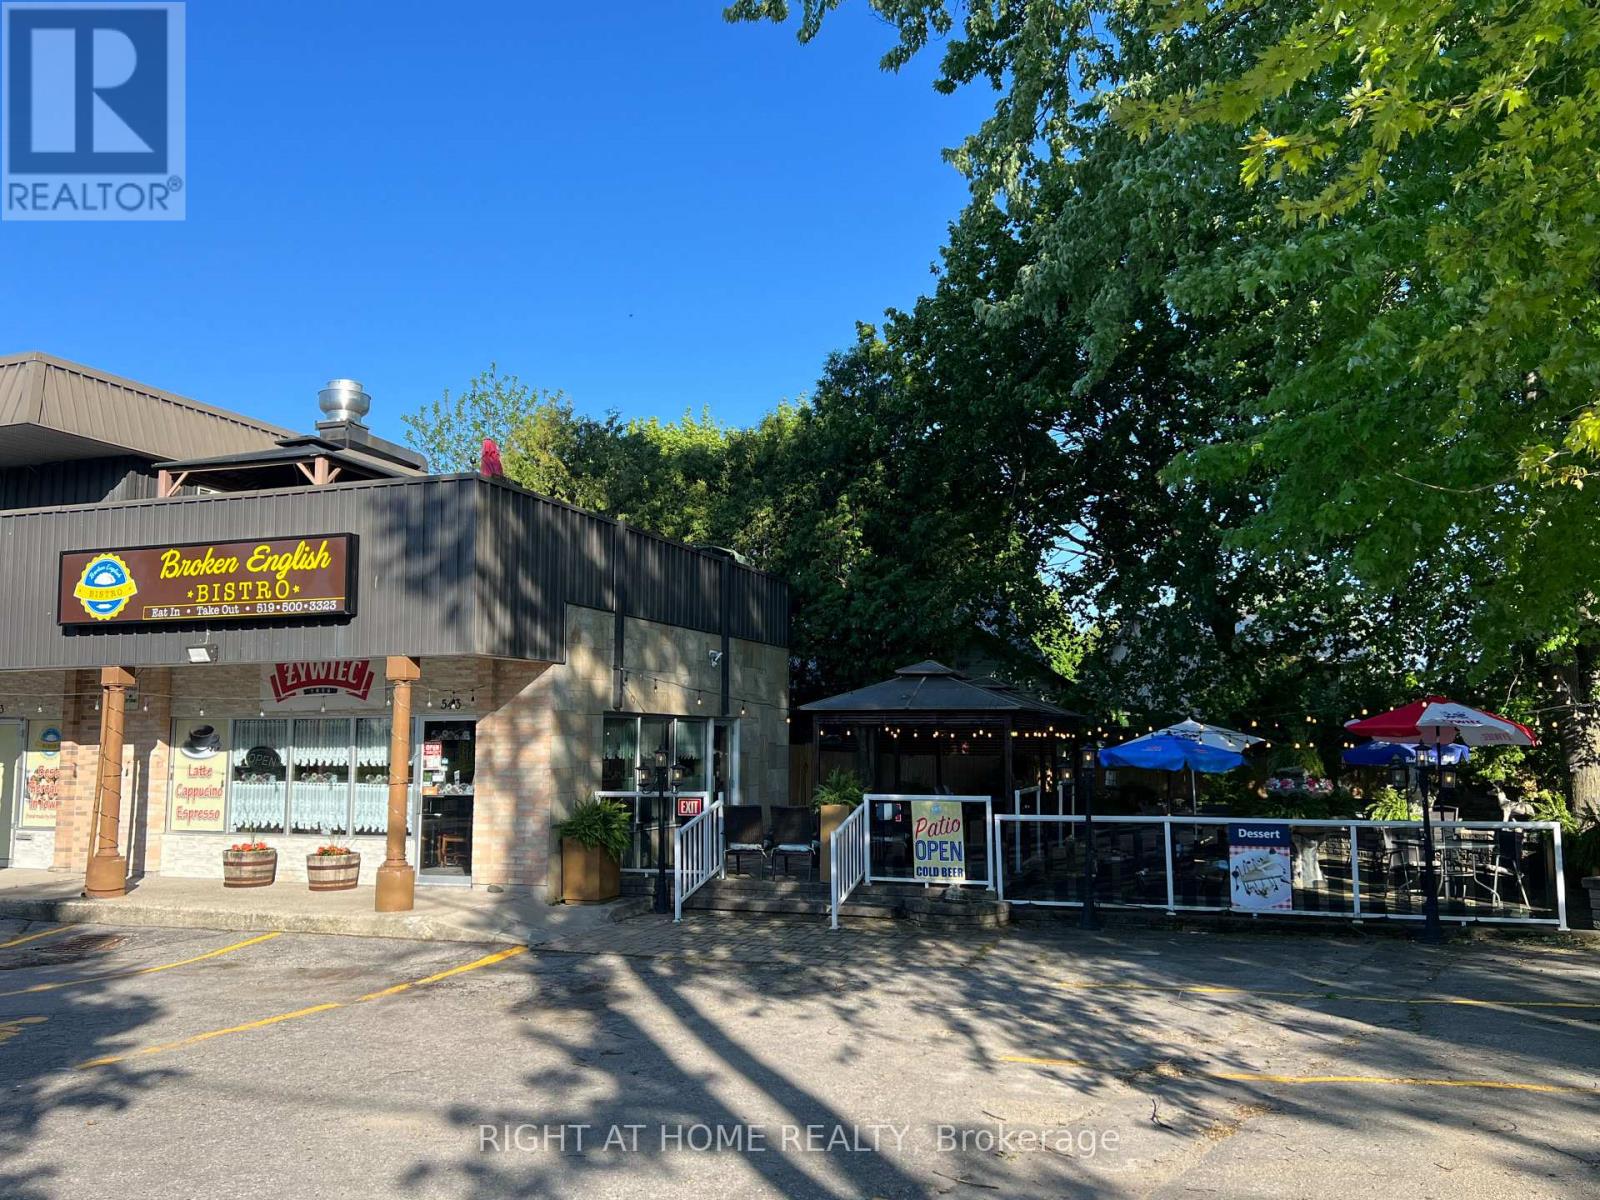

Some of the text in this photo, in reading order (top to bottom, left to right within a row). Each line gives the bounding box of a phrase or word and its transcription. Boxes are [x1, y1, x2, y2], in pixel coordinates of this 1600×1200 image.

[160, 540, 331, 580] Broken English
[89, 588, 123, 598] BISTRO
[196, 580, 290, 602] BISTRO
[151, 607, 180, 617] Eat In
[196, 604, 240, 615] Take Out
[248, 753, 277, 766] OPEN
[187, 764, 213, 777] Latte
[680, 800, 698, 813] EXIT
[176, 805, 221, 826] Espresso
[915, 816, 961, 840] Patio
[1238, 828, 1280, 839] Dessert
[915, 840, 963, 861] OPEN
[916, 866, 964, 877] COLD BEER
